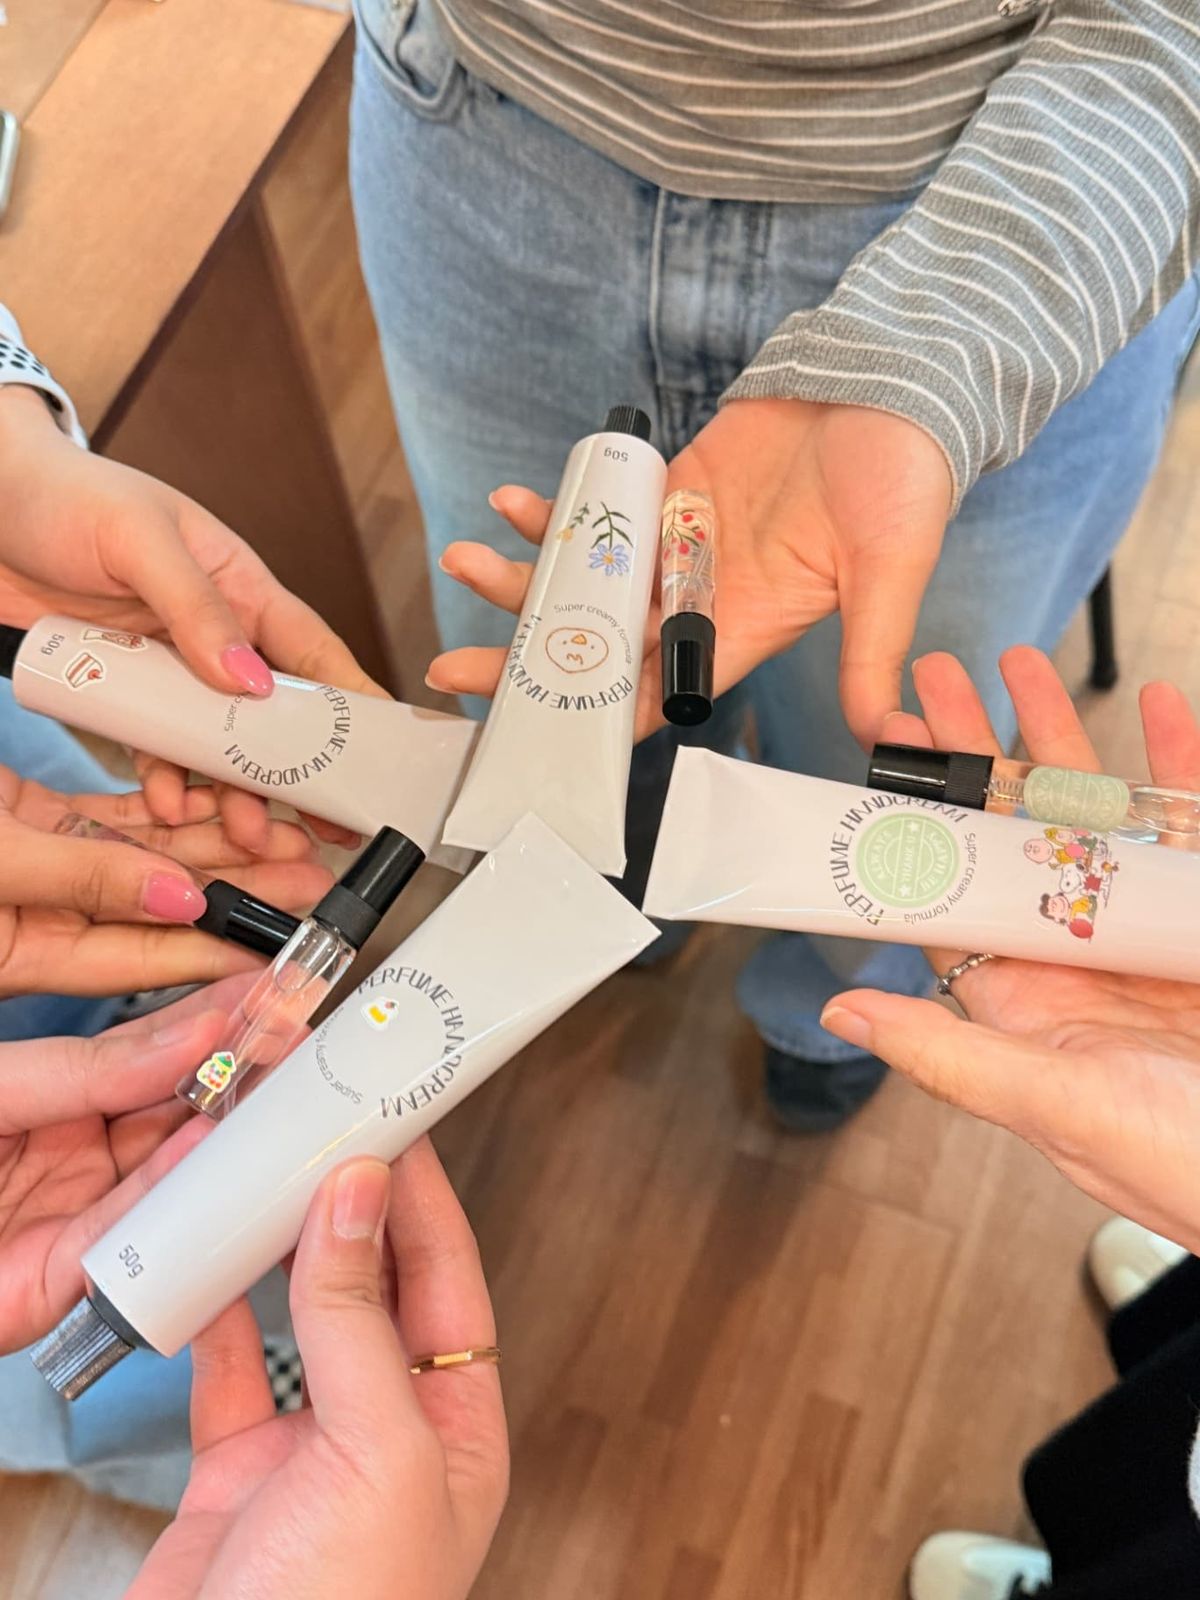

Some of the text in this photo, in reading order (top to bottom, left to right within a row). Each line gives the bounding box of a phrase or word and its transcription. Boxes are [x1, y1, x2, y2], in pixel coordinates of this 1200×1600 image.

[604, 447, 629, 463] 50g
[553, 603, 585, 614] Super
[586, 604, 620, 628] creamy
[41, 633, 65, 656] 50g
[548, 675, 634, 711] PERFUME
[224, 704, 237, 732] Super
[224, 684, 351, 786] PERFUME HANDCREAM
[840, 794, 968, 832] HANDCREAM
[903, 832, 977, 925] Super creamy formula
[357, 966, 453, 1008] PERFUME
[330, 1079, 364, 1105] Super
[119, 1244, 144, 1279] 50g
